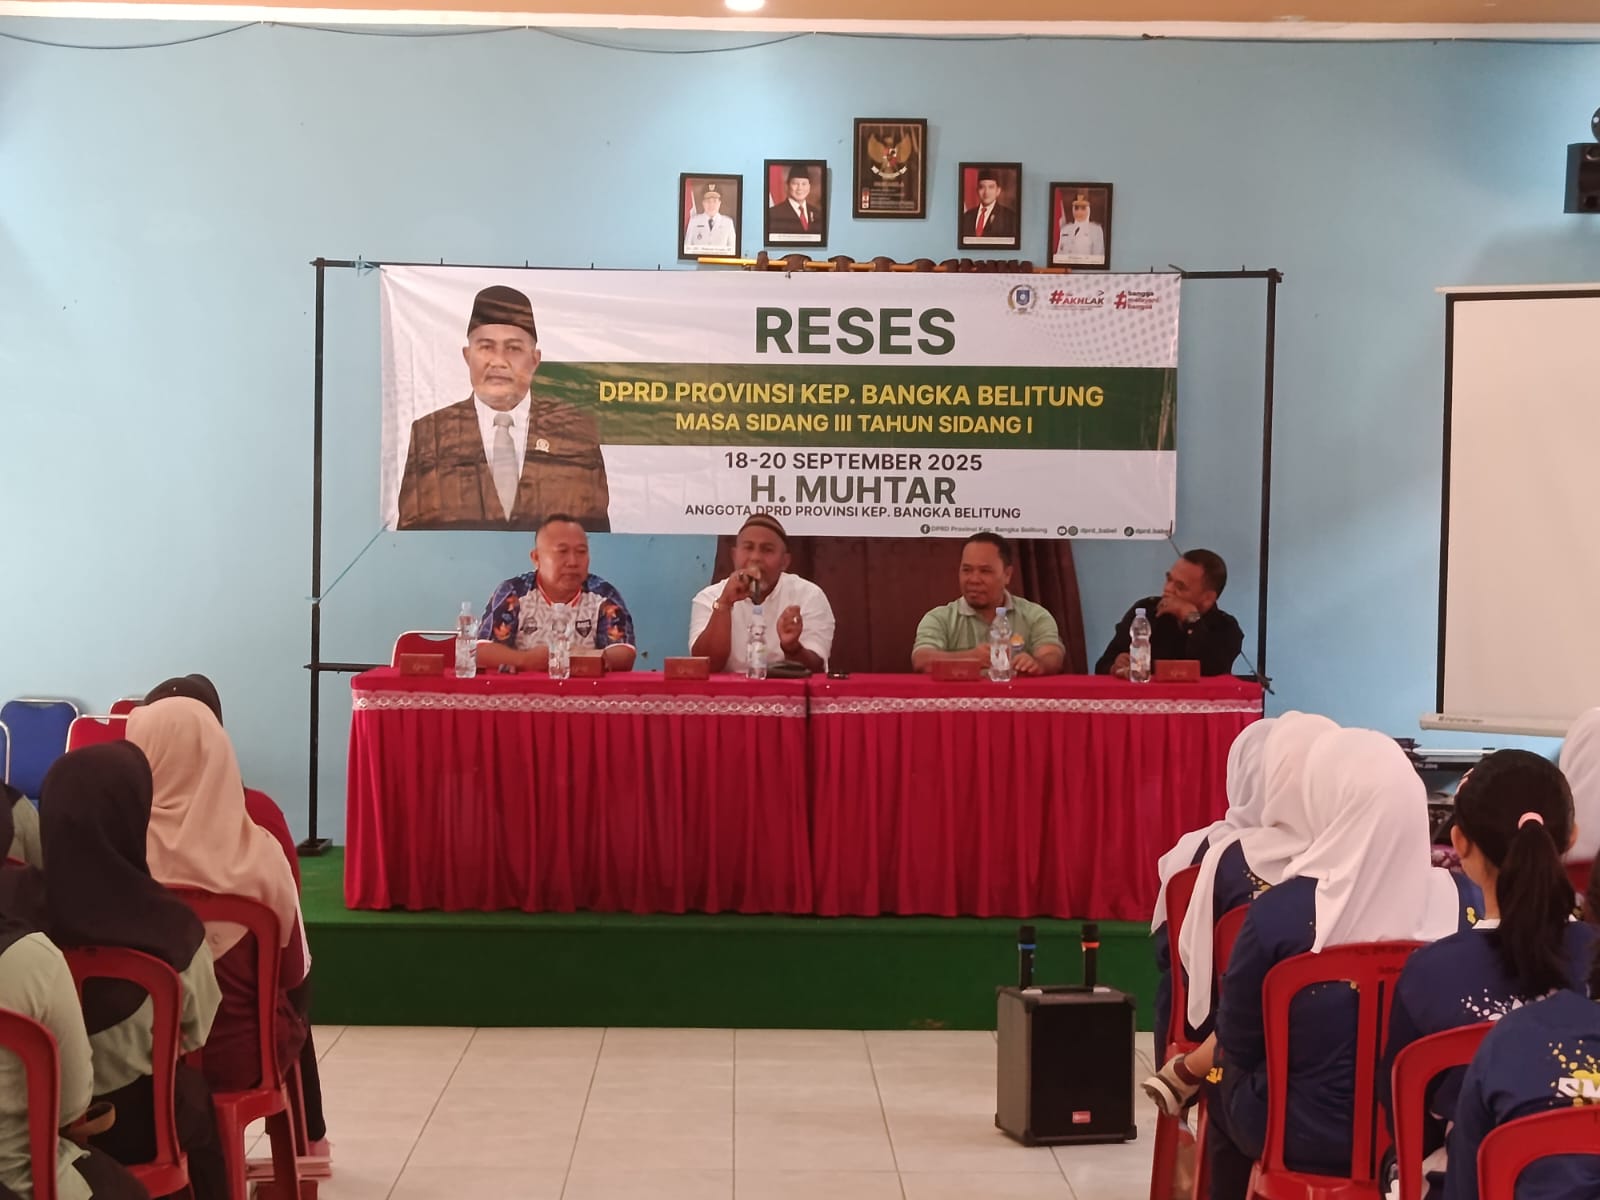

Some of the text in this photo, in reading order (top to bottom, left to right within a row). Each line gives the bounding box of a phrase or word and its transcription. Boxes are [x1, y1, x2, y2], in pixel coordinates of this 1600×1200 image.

[755, 306, 956, 356] RESES
[599, 381, 1105, 407] DPRD PROVINSI KEP. BANGKA BELITUNG
[675, 412, 1034, 434] MASA SIDANG III TAHUN SIDANG I
[724, 451, 983, 471] 18-20 SEPTEMBER 2025
[750, 474, 957, 505] H. MUHTAR
[685, 504, 1021, 519] ANGGOTA DPRD PROVINSI KEP. BANGKA BELITUNG
